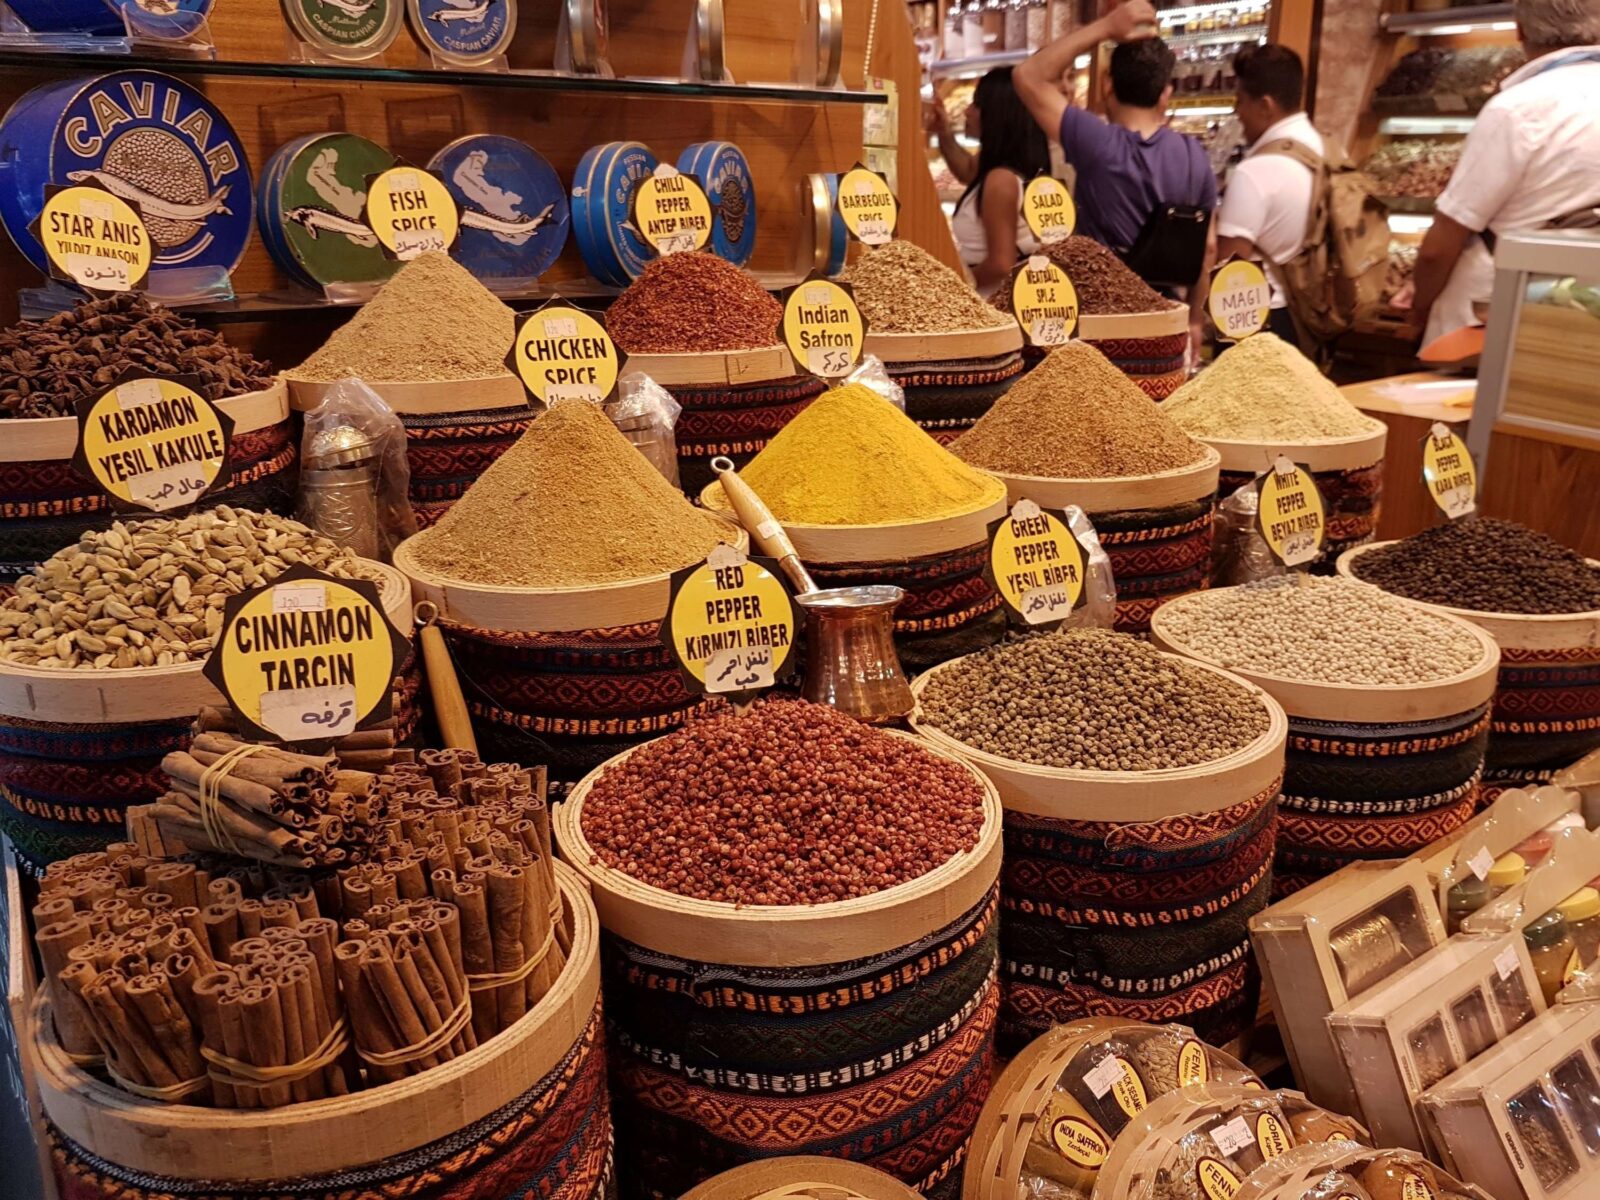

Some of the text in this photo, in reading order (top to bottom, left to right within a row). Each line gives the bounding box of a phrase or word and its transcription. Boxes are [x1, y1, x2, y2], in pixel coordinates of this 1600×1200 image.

[312, 13, 348, 38] CASPIAN
[349, 19, 377, 38] CAVIAR
[480, 16, 502, 46] CAVIAR
[65, 82, 239, 185] CAVIAR
[654, 177, 685, 193] CHILLI
[389, 190, 428, 212] FISH
[656, 197, 692, 214] PEPPER
[842, 193, 892, 208] BARBEQUE
[1032, 193, 1063, 209] SALAD
[50, 211, 141, 246] STAR ANIS
[391, 216, 437, 231] SPICE
[648, 218, 676, 235] ANTEP
[858, 212, 883, 222] SPICE
[1038, 212, 1066, 228] SPICE
[1222, 288, 1260, 311] MAGI
[798, 305, 849, 325] Indian
[1228, 310, 1258, 330] SPICE
[524, 338, 607, 362] CHICKEN
[800, 329, 853, 349] Safron
[545, 367, 597, 385] SPICE
[99, 396, 199, 444] KARDAMON
[152, 429, 223, 469] KAKULE
[1273, 470, 1299, 490] WHITE
[1276, 492, 1307, 515] PEPPER
[1010, 514, 1051, 539] GREEN
[1014, 540, 1060, 566] PEPPER
[715, 566, 744, 590] RED
[706, 595, 762, 624] PEPPER
[235, 605, 373, 654] CINNAMON
[260, 653, 356, 692] TARCIN
[1128, 1084, 1144, 1112] SESAME
[1060, 1123, 1105, 1156] INDIA SAFFRON
